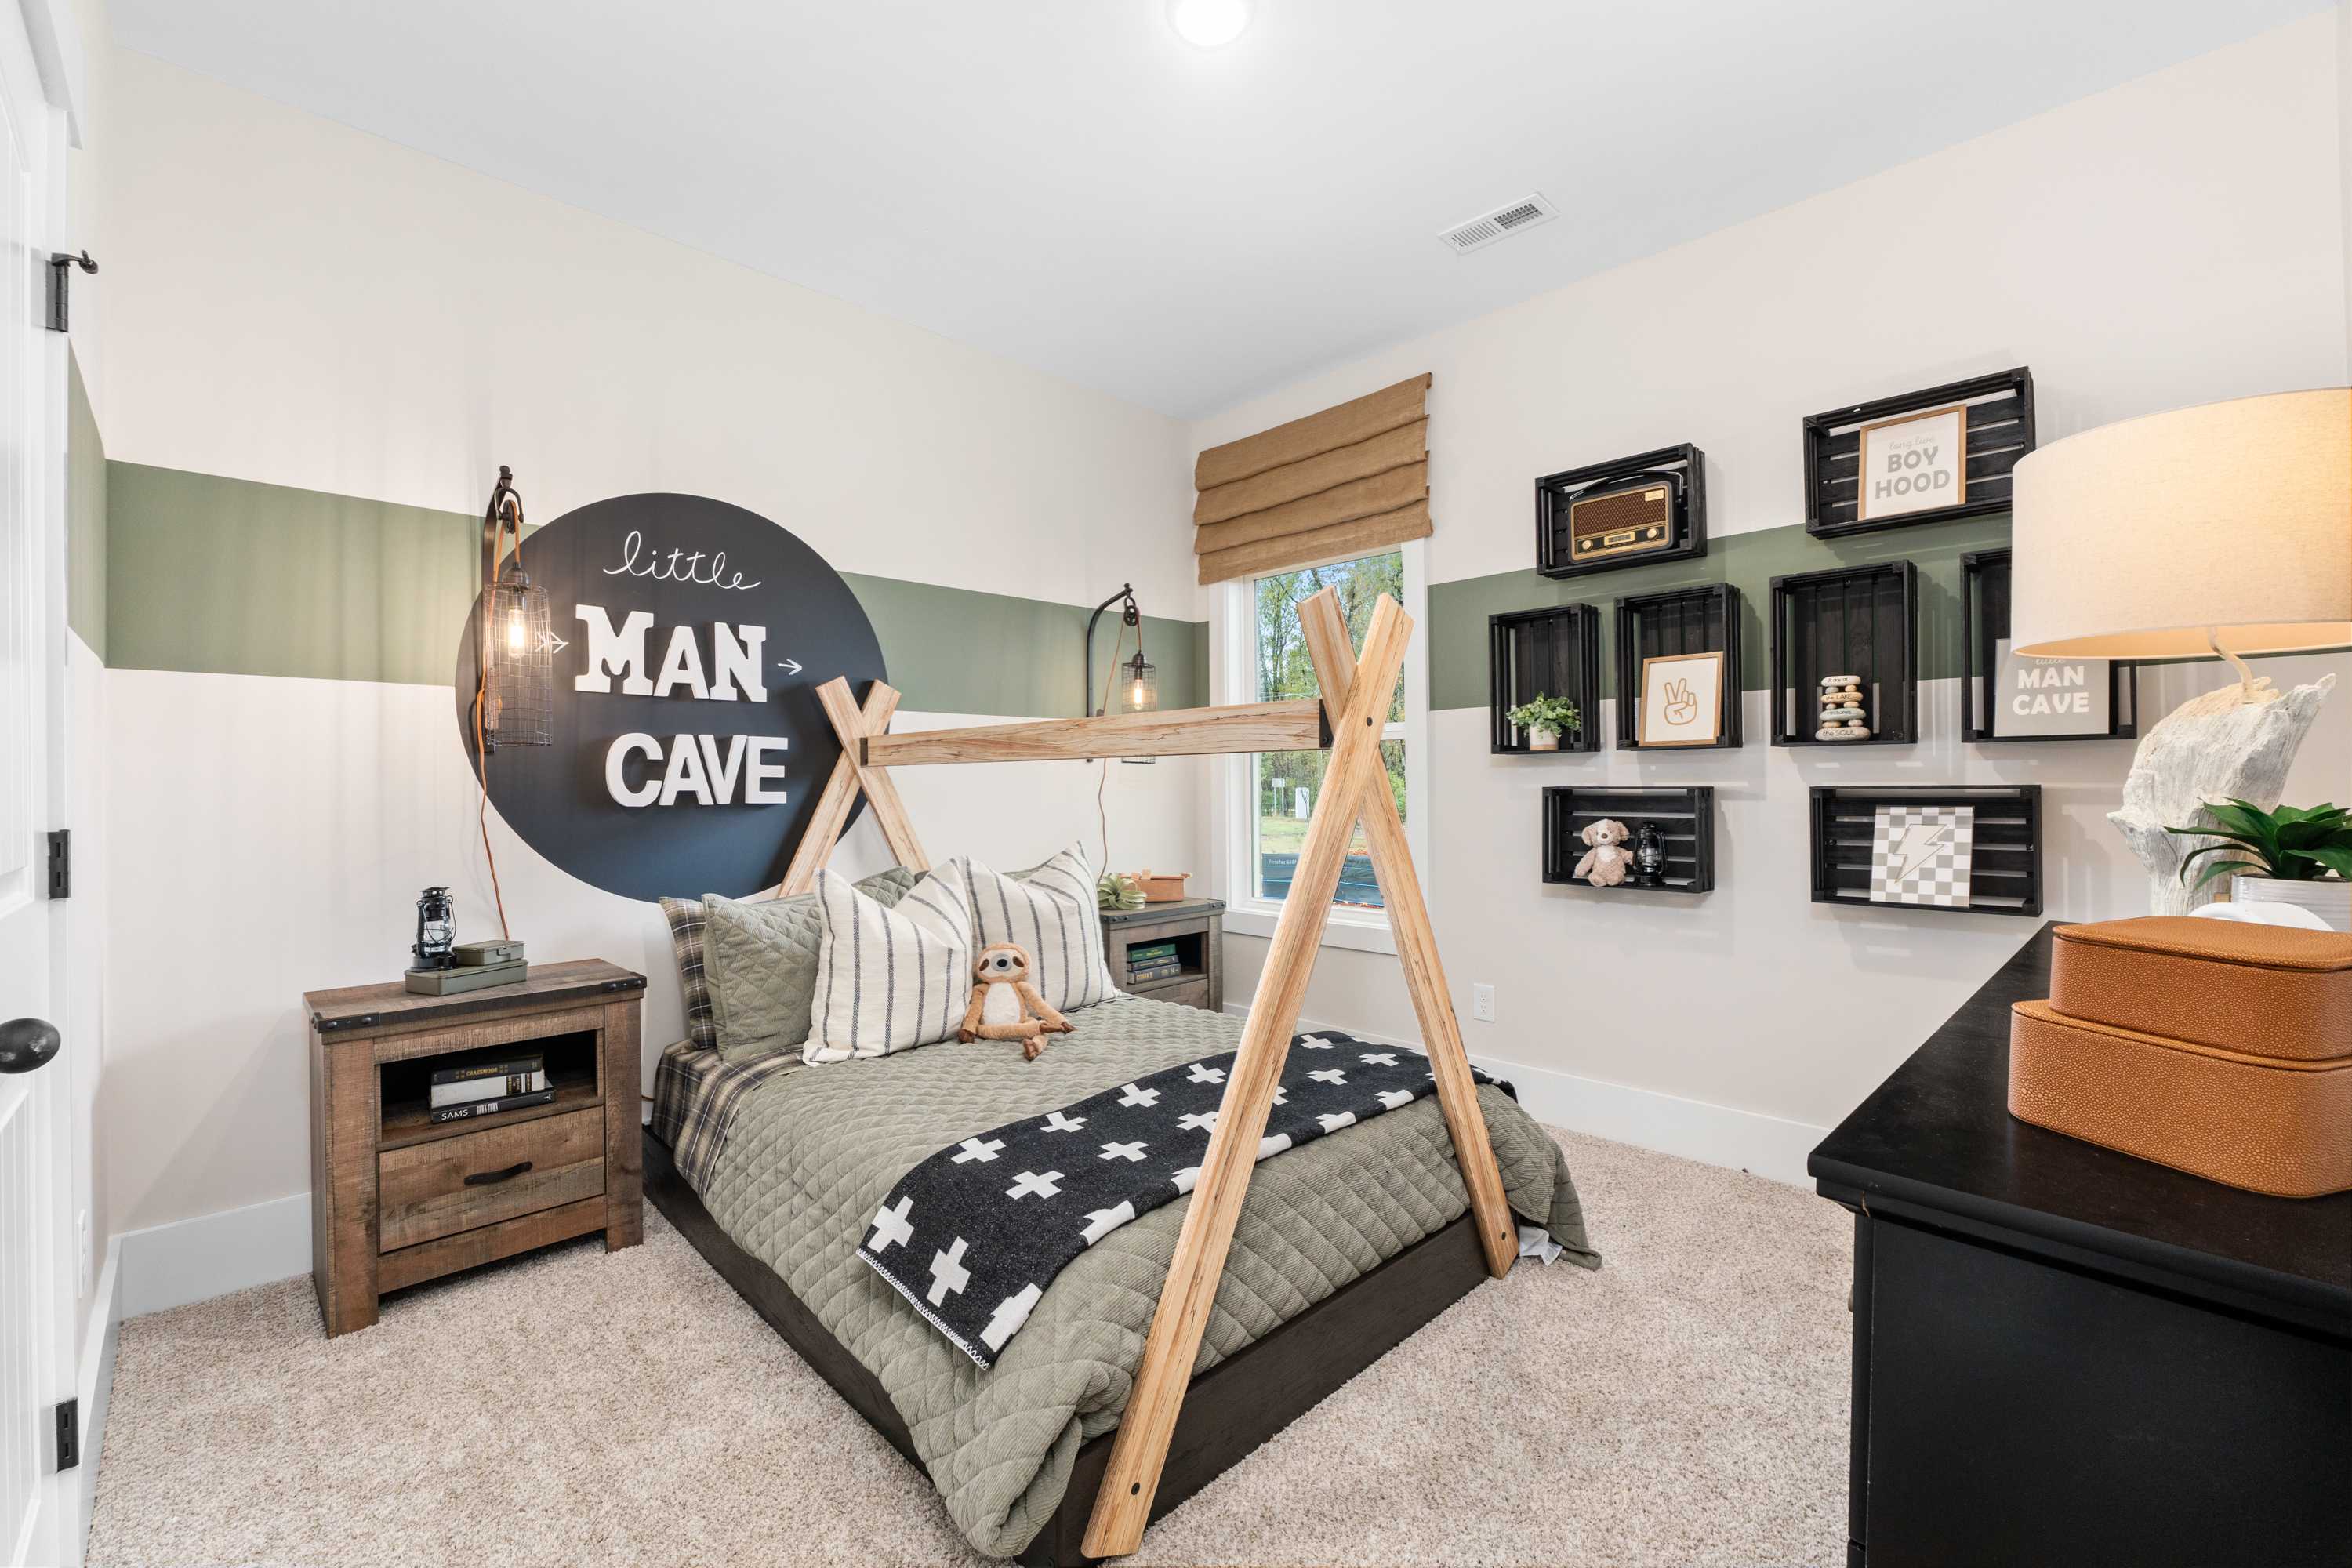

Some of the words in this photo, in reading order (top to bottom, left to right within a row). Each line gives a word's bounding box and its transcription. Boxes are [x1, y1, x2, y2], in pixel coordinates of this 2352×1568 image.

[1888, 445, 1938, 473] BOY
[1875, 470, 1951, 499] HOOD
[604, 530, 761, 590] little
[575, 604, 767, 702] MAN
[2017, 666, 2085, 689] MAN
[2013, 692, 2089, 716] CAVE
[605, 732, 789, 808] CAVE
[441, 1109, 469, 1120] SAMS
